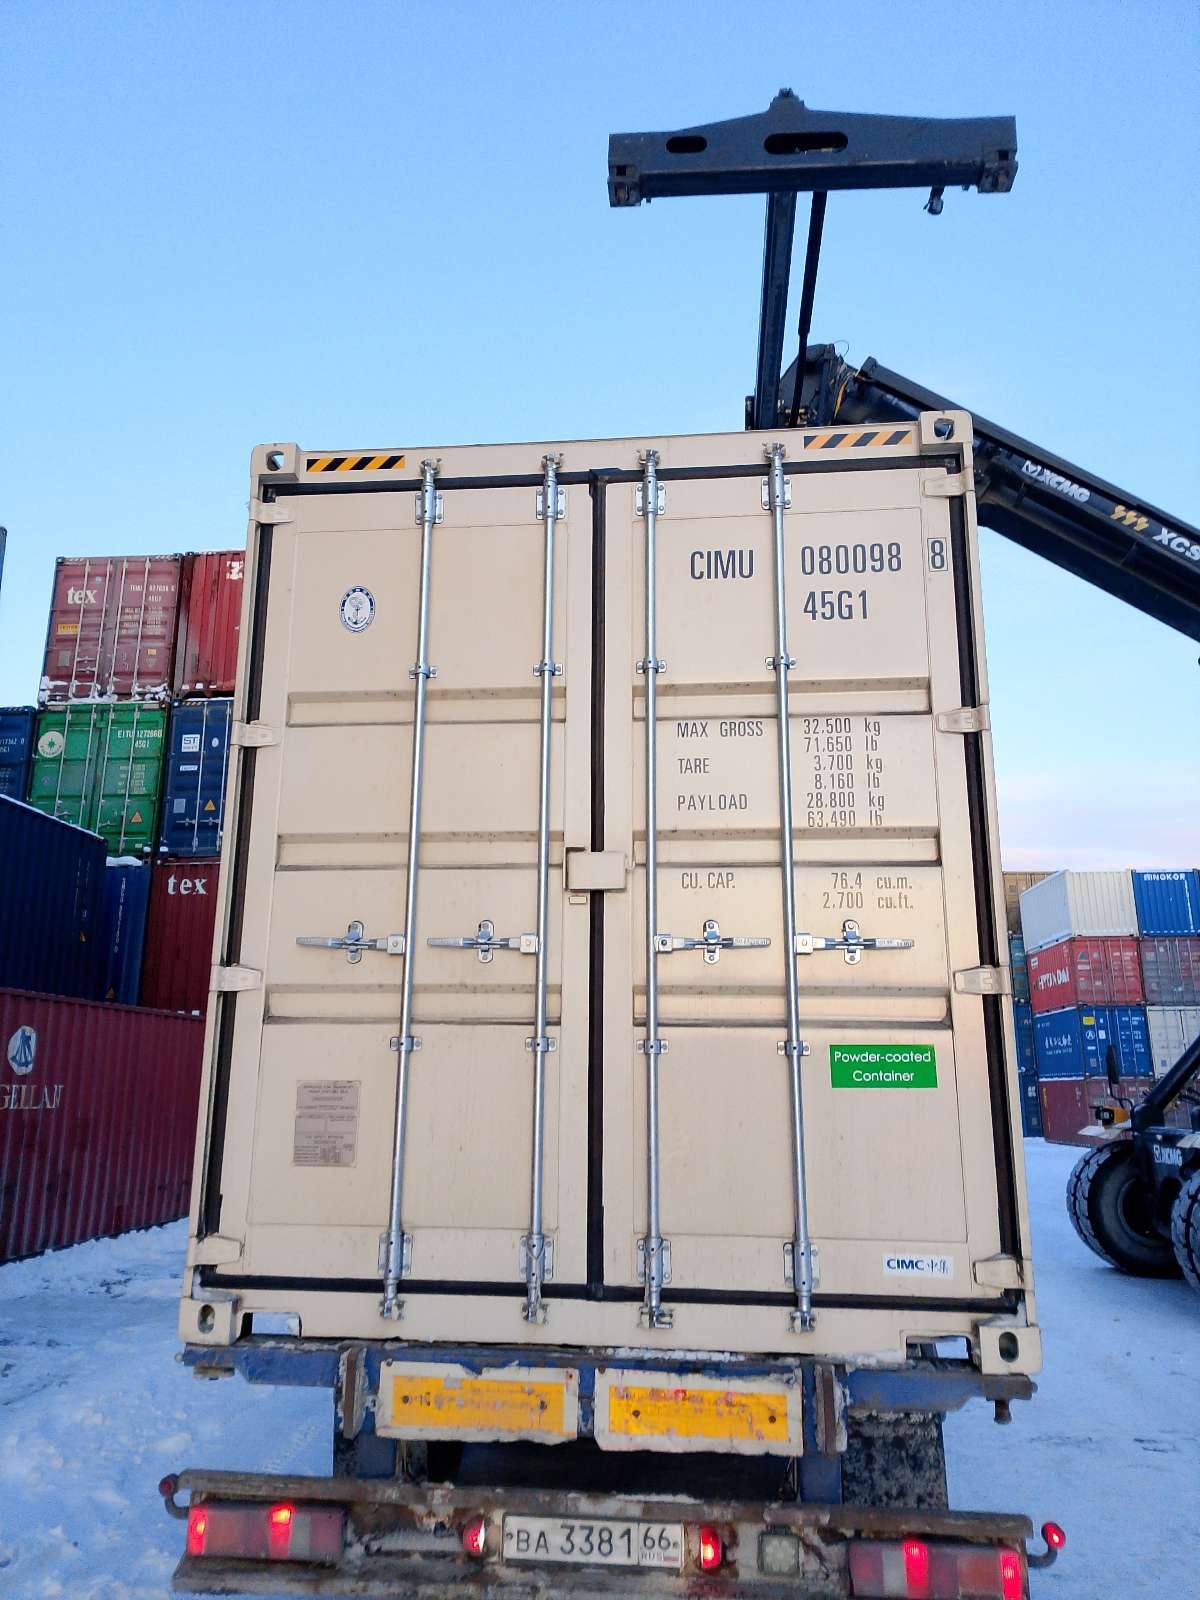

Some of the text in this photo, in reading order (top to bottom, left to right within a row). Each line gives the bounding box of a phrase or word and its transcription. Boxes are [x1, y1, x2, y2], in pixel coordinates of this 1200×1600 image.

[690, 539, 945, 580] CIMU 080098 8
[67, 585, 97, 605] tex
[803, 590, 868, 620] 45G1
[677, 721, 709, 738] MAX
[719, 720, 764, 737] GROSS
[864, 717, 881, 736] kg
[865, 735, 879, 752] lb
[677, 757, 710, 775] TARE
[866, 754, 883, 773] kg
[867, 773, 881, 789] lb
[677, 793, 749, 812] PAYLOAD
[868, 791, 886, 811] kg
[869, 810, 883, 827] lb
[167, 873, 208, 896] tex
[681, 872, 913, 890] CU. CAP. 76.4 cu.m.
[877, 891, 914, 909] cu.ft.
[834, 1050, 931, 1063] Powder-coated
[852, 1069, 915, 1082] Container
[886, 1258, 924, 1271] CIMC
[560, 1523, 633, 1558] 3381
[642, 1525, 671, 1551] 66
